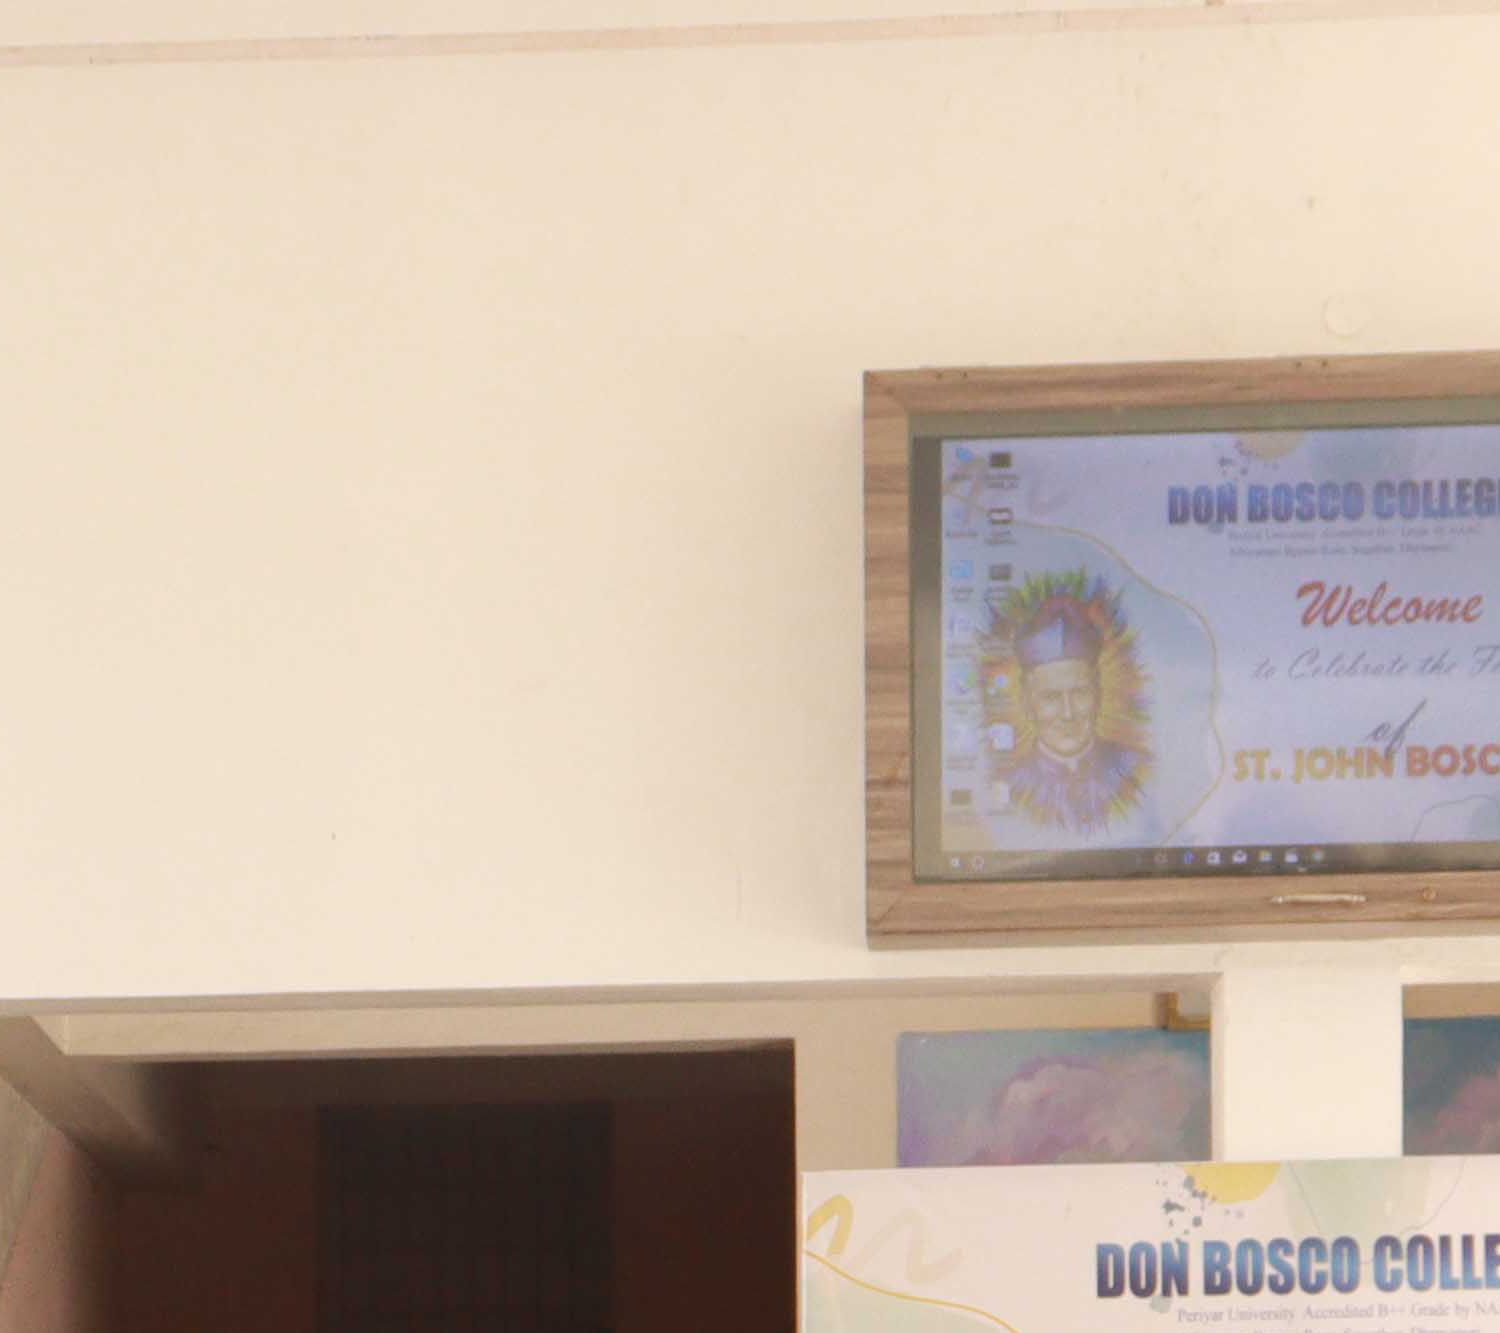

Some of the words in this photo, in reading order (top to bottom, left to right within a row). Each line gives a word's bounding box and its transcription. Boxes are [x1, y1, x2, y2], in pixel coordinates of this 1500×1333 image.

[1168, 484, 1238, 526] DON
[1249, 482, 1362, 523] BOSCO
[1295, 581, 1483, 628] Welcome
[1252, 660, 1275, 680] to
[1289, 651, 1410, 681] Celebrate
[1415, 651, 1456, 679] the
[1366, 701, 1428, 764] of
[1232, 748, 1280, 781] ST.
[1293, 746, 1393, 780] JOHN
[1095, 1239, 1191, 1298] DON
[1202, 1236, 1360, 1296] BOSCO
